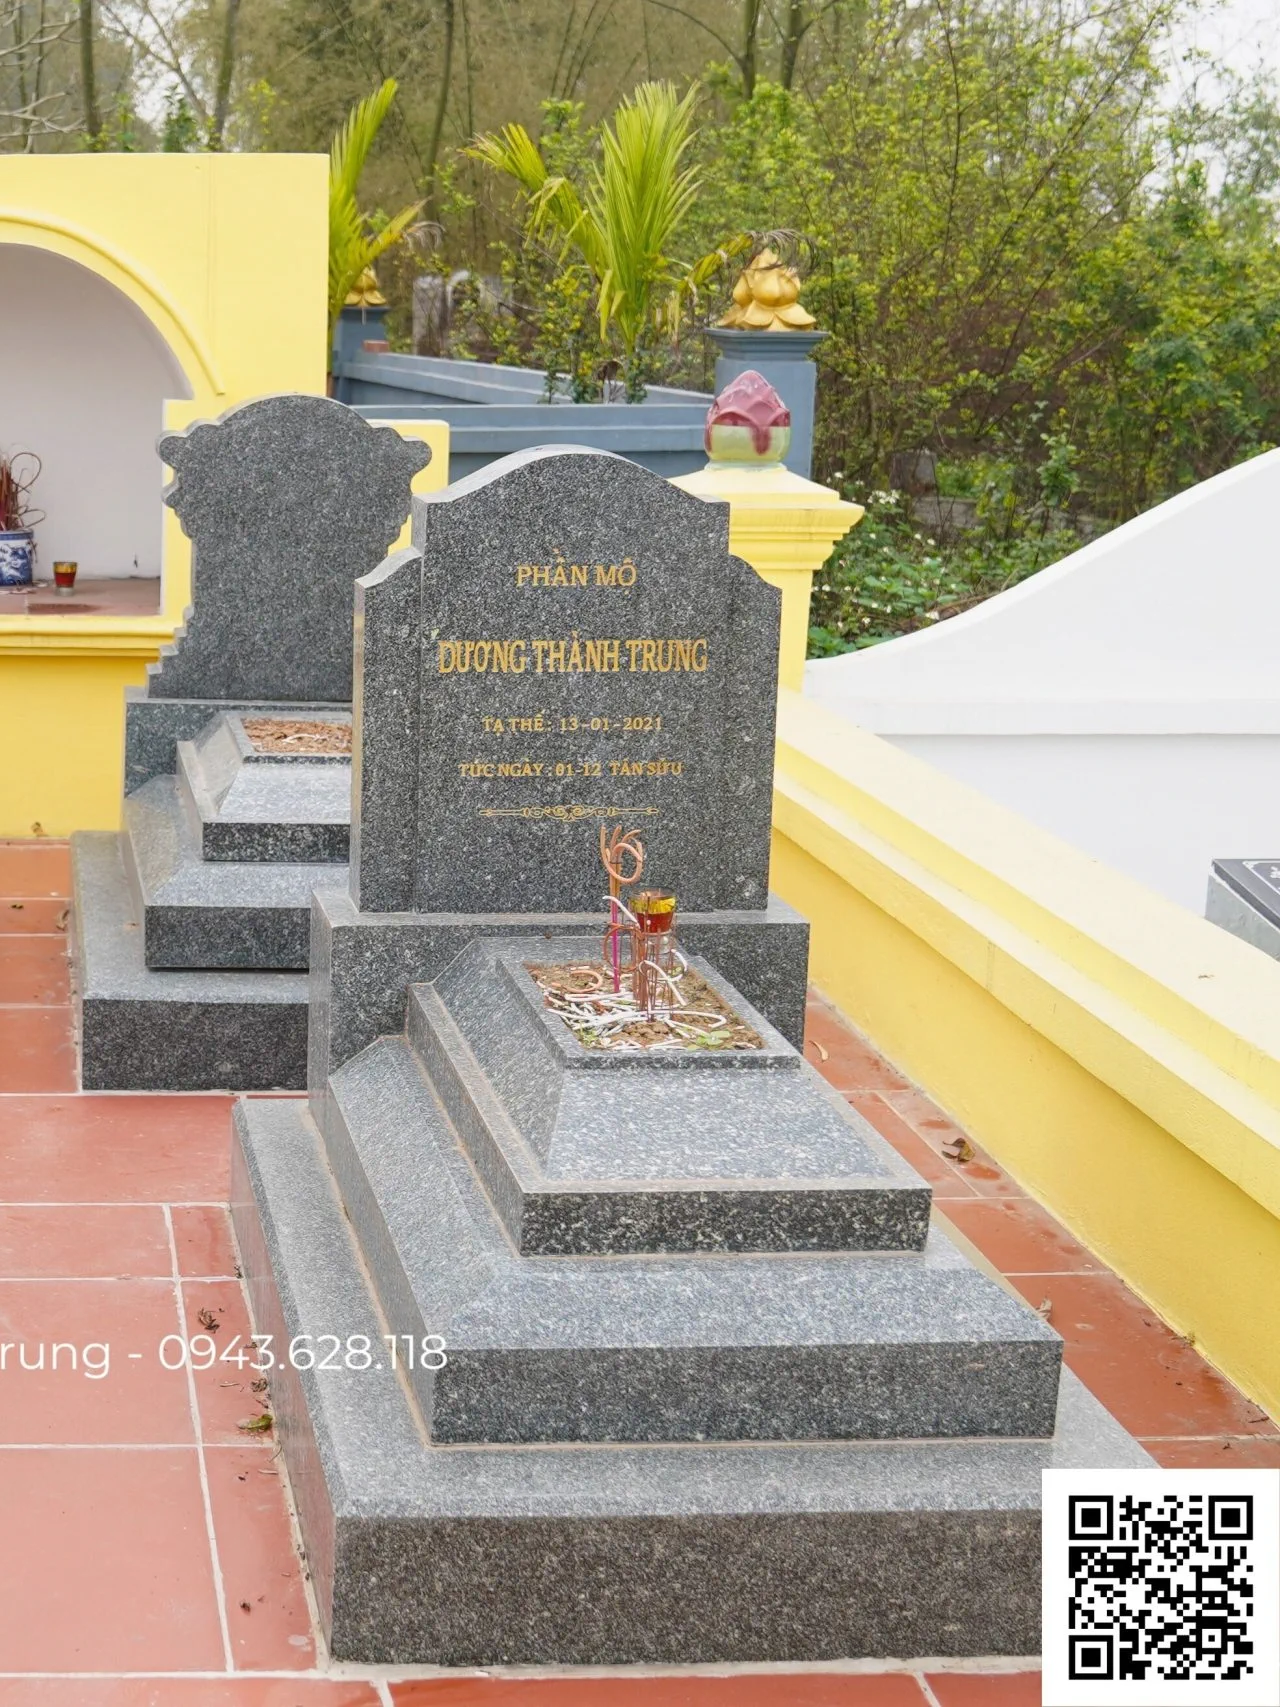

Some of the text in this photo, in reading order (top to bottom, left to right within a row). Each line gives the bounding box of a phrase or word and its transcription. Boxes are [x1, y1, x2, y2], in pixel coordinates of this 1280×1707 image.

[516, 549, 638, 596] PHẦN MỘ
[438, 630, 709, 674] DƯƠNG THÀNH TRUNG
[482, 717, 506, 737] TẠ
